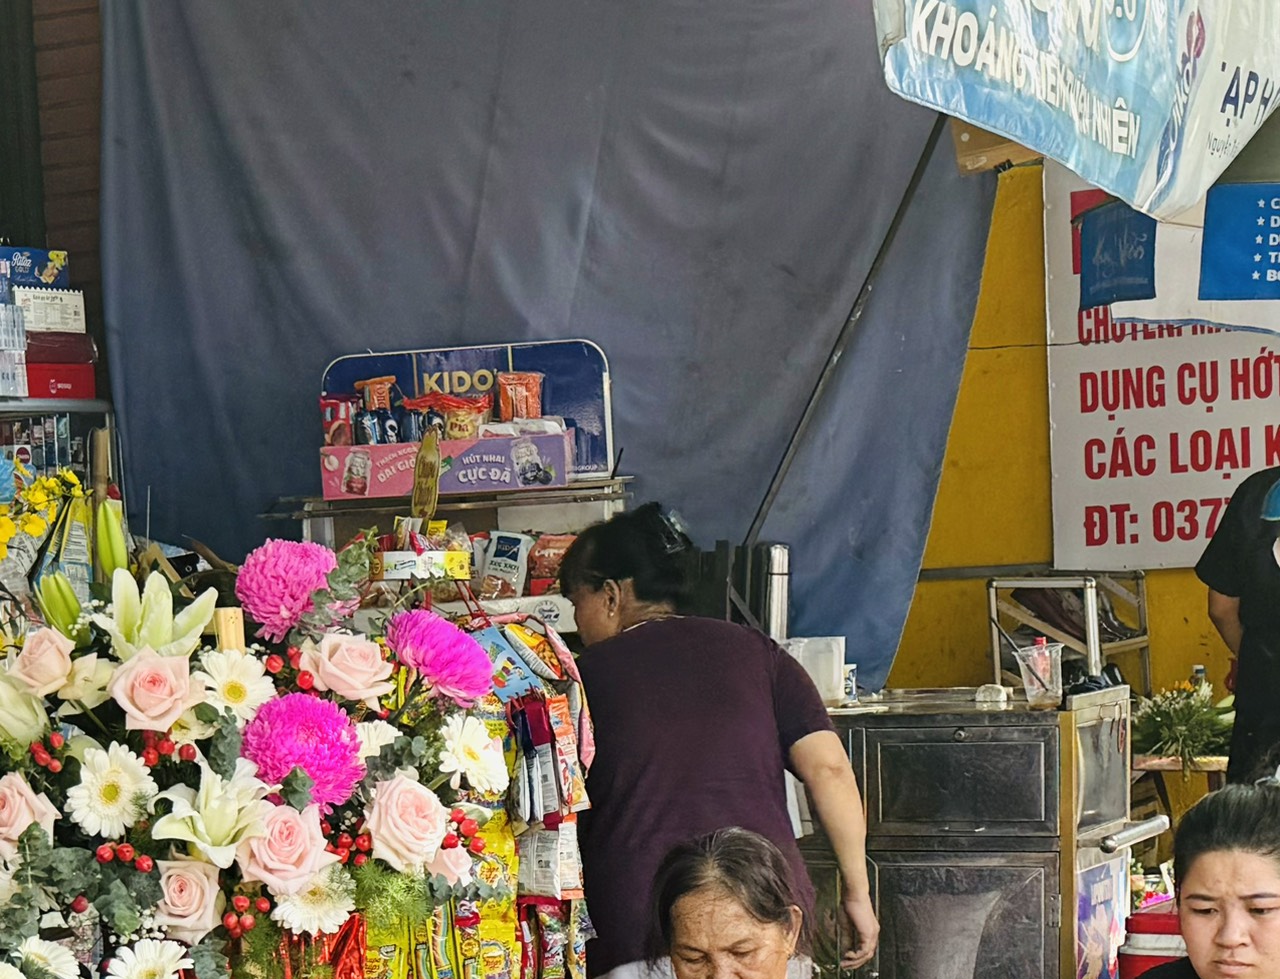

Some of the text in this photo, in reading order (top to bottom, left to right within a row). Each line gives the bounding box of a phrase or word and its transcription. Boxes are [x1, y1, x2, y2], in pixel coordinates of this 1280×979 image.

[1080, 365, 1167, 421] DỤNG
[1176, 360, 1219, 413] CỤ
[462, 453, 481, 465] HÚT
[1084, 427, 1156, 480] CÁC
[1169, 426, 1251, 480] LOẠI
[457, 466, 490, 486] CỰC
[1083, 503, 1139, 547] ĐT:
